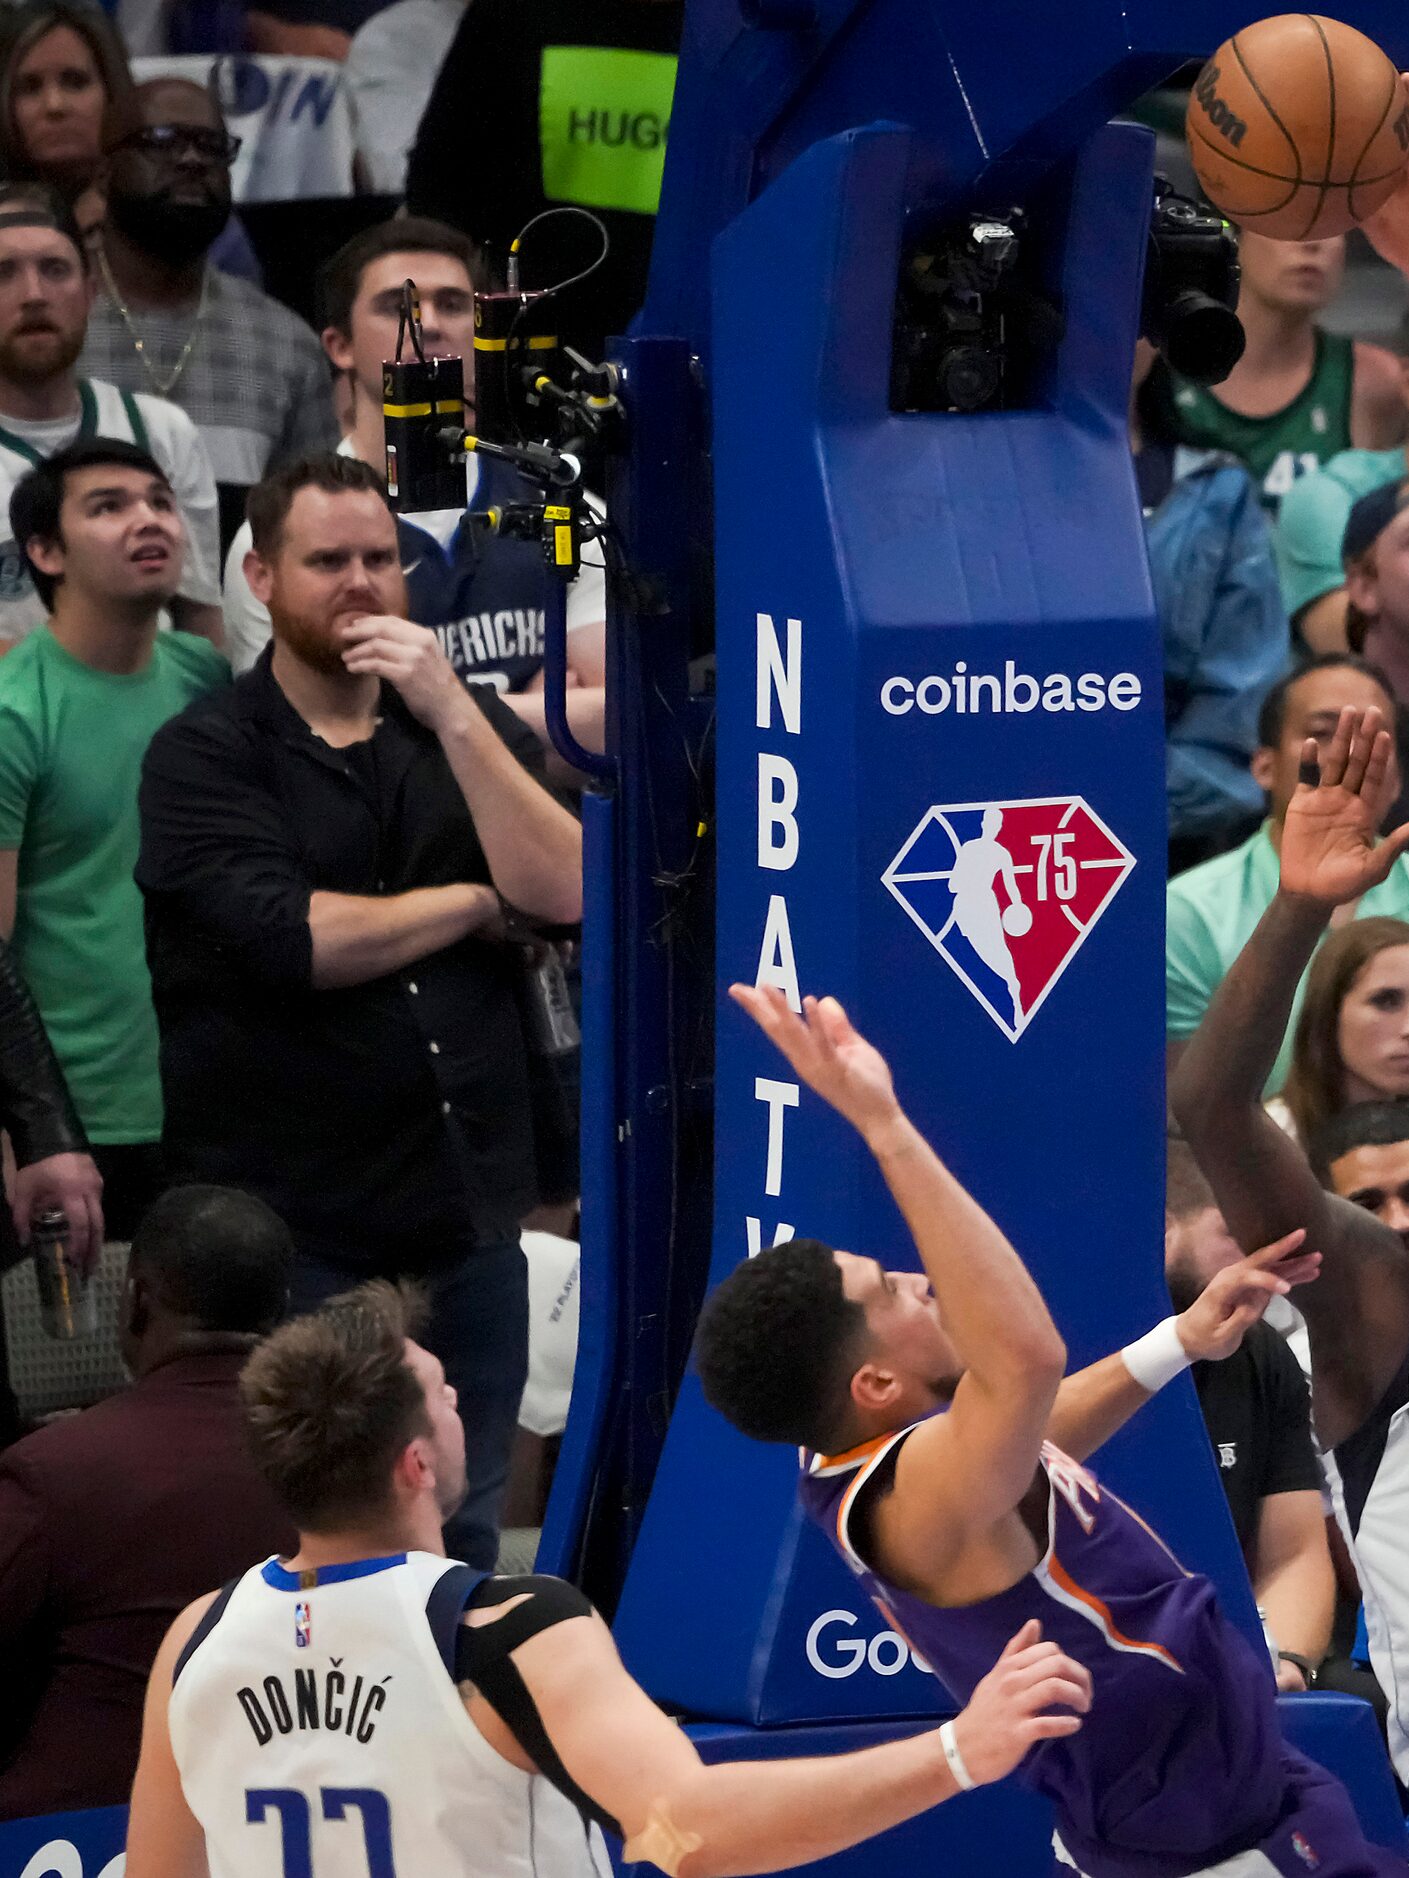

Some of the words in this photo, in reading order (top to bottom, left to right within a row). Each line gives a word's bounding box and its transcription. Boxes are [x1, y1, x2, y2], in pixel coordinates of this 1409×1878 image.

[567, 105, 671, 151] HUG
[880, 660, 1142, 716] coinbase
[1030, 833, 1078, 902] 75
[236, 1656, 393, 1747] DONČIĆ
[244, 1786, 397, 1878] 77
